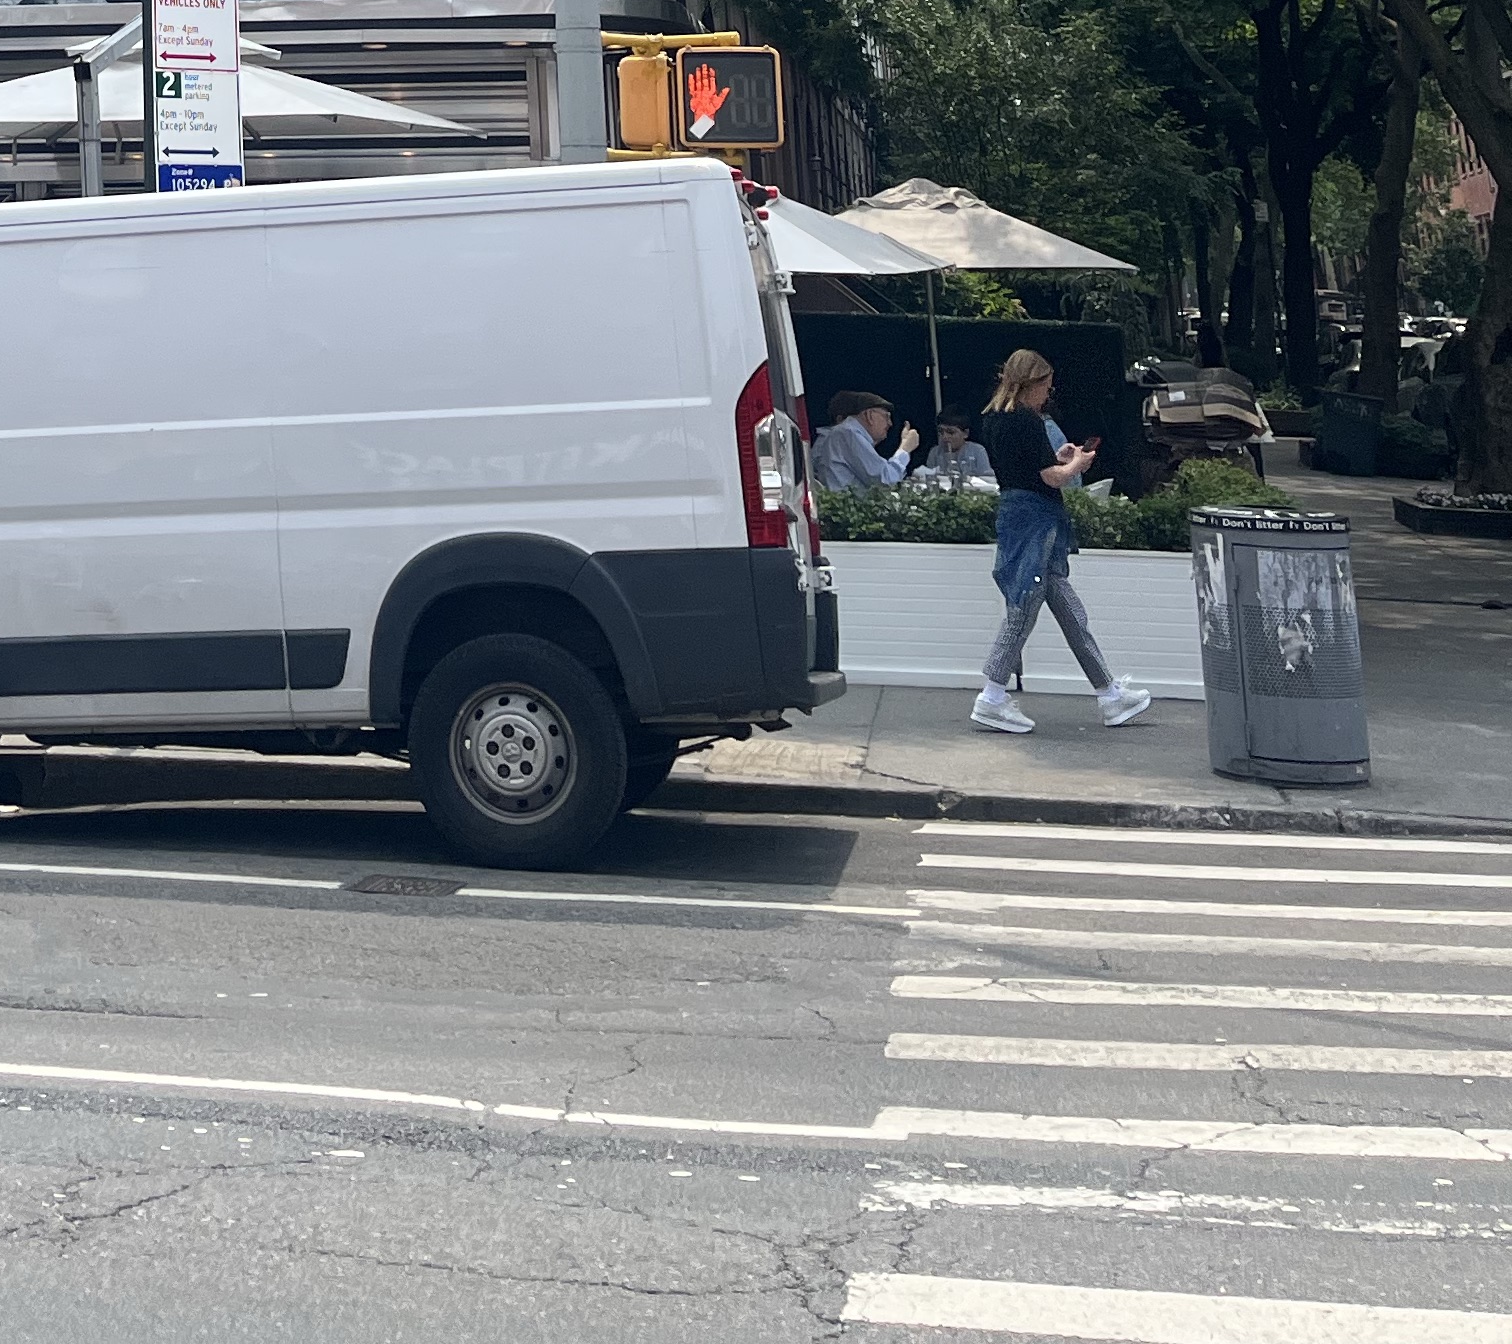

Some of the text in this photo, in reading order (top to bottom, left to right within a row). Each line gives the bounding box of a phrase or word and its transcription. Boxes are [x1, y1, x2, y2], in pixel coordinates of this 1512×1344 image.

[158, 22, 175, 32] 7am
[182, 24, 199, 35] 4pm
[158, 35, 214, 47] Except Sunday
[162, 72, 176, 96] 2
[184, 82, 213, 91] metered
[184, 109, 205, 120] 10pm
[160, 121, 218, 133] Except Sunday
[172, 178, 216, 191] 105294
[1222, 517, 1284, 530] Don't litter
